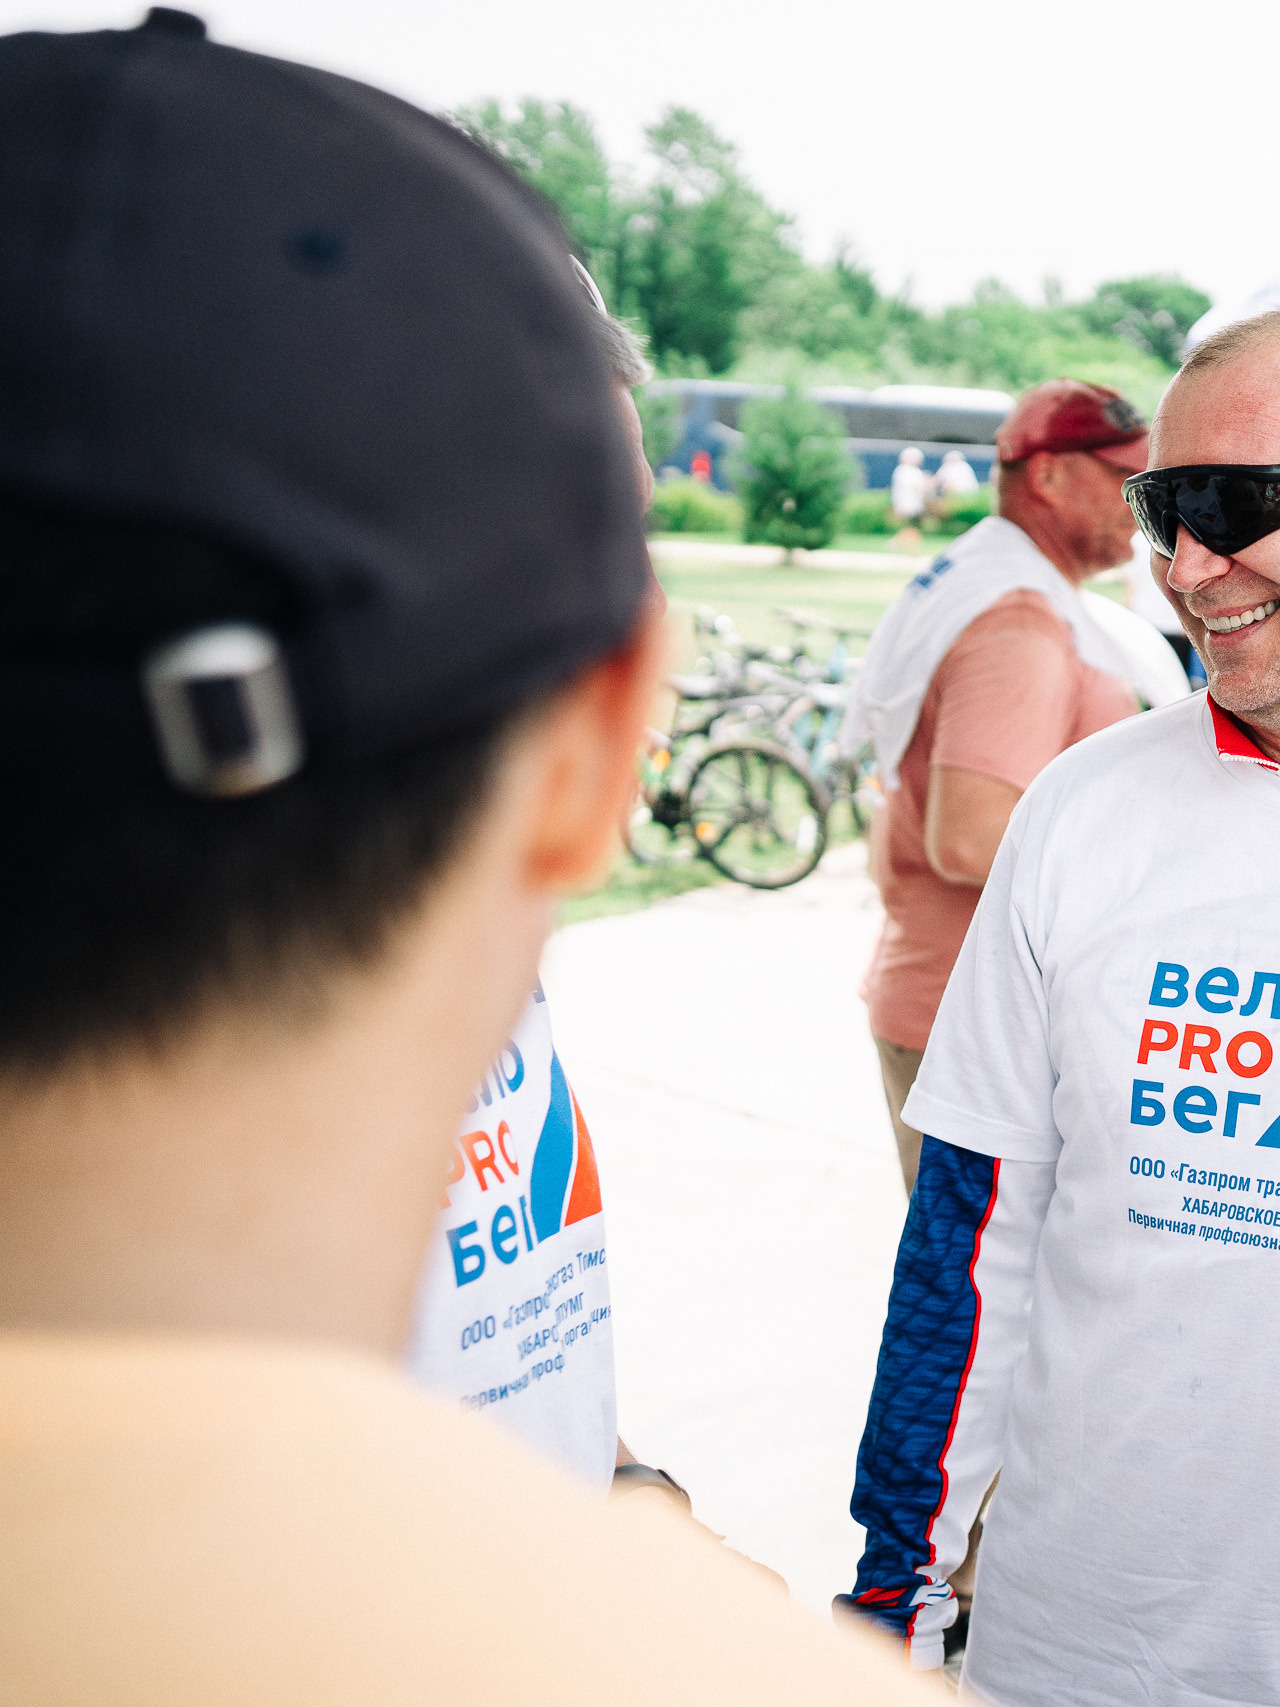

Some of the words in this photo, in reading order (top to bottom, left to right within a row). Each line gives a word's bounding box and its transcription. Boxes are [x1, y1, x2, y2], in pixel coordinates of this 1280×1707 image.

[1136, 1018, 1274, 1079] PRO
[1128, 1155, 1167, 1179] ООО
[1170, 1162, 1251, 1194] «Газпром
[1127, 1207, 1197, 1237] Первичная
